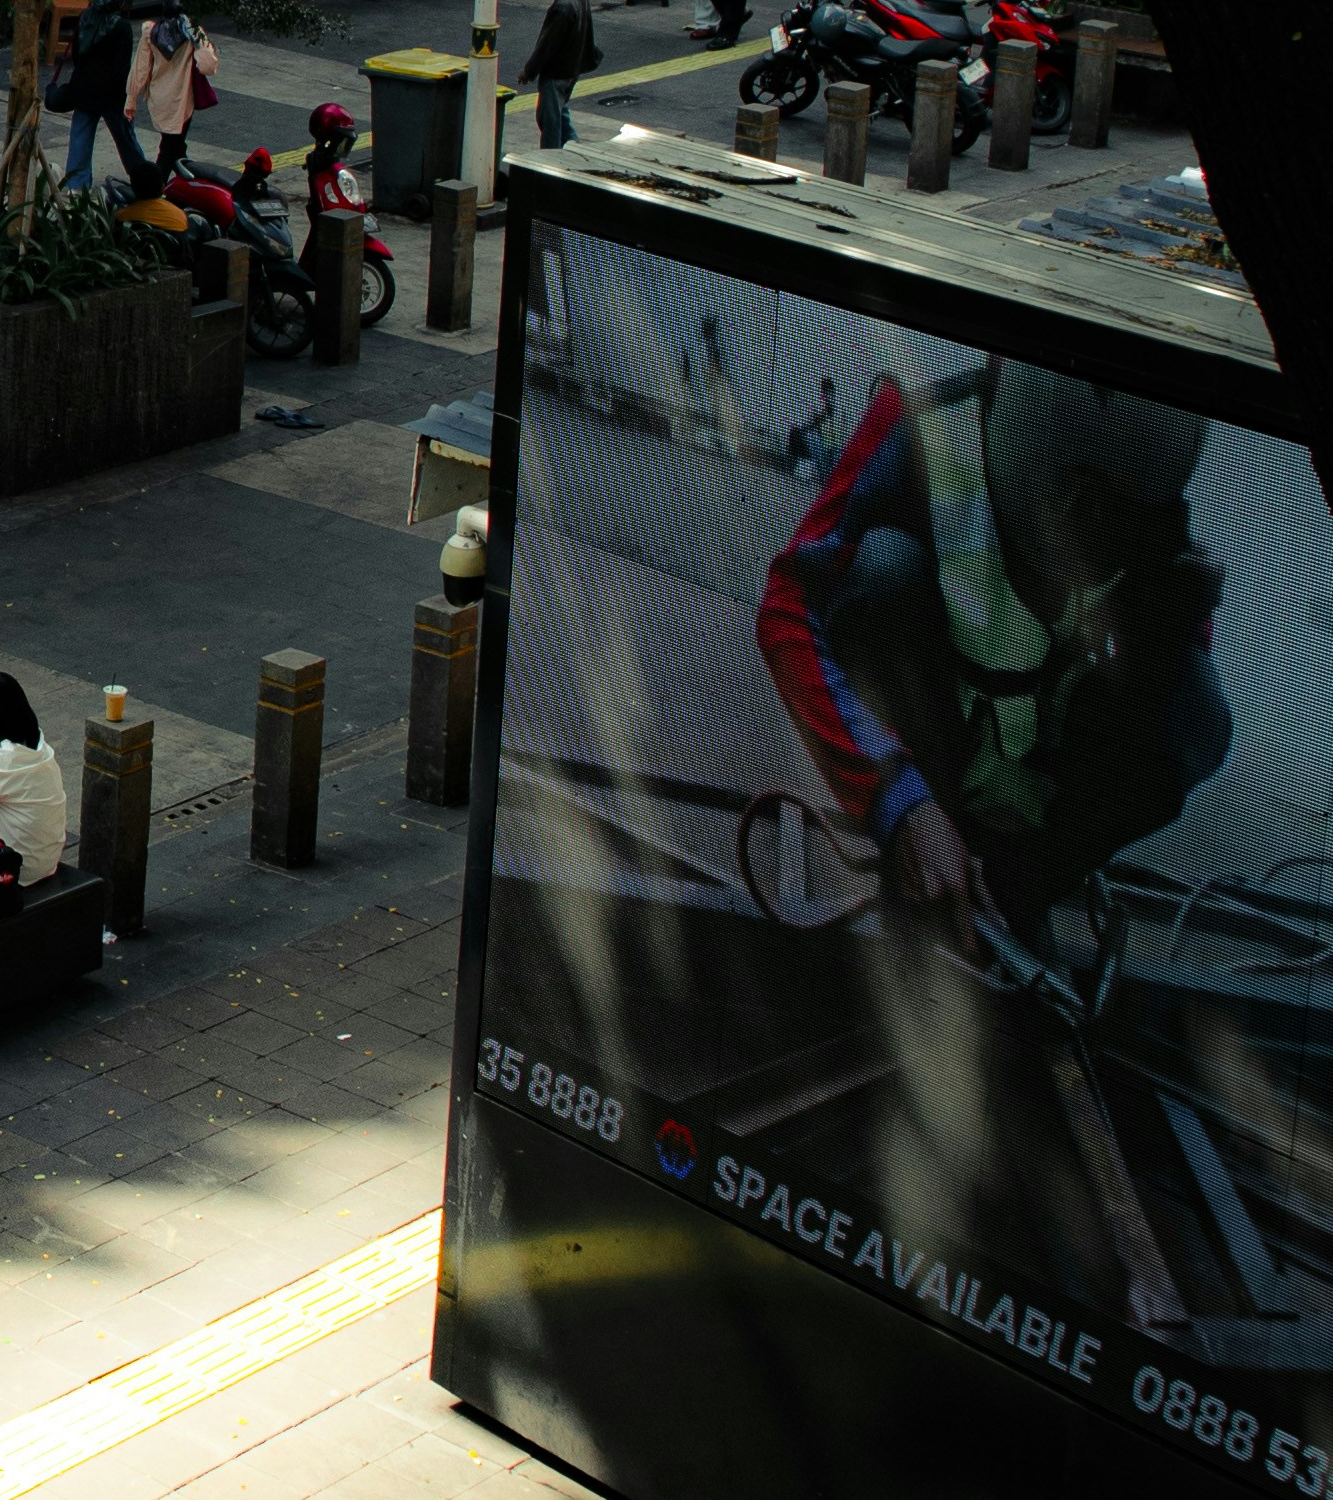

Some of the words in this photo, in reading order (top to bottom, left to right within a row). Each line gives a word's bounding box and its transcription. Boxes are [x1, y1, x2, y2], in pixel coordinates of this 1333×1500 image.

[477, 1037, 525, 1093] 35
[527, 1061, 625, 1143] 8888
[712, 1154, 853, 1259] SPACE
[852, 1229, 1103, 1384] AVAILABLE
[1132, 1363, 1260, 1462] 0888
